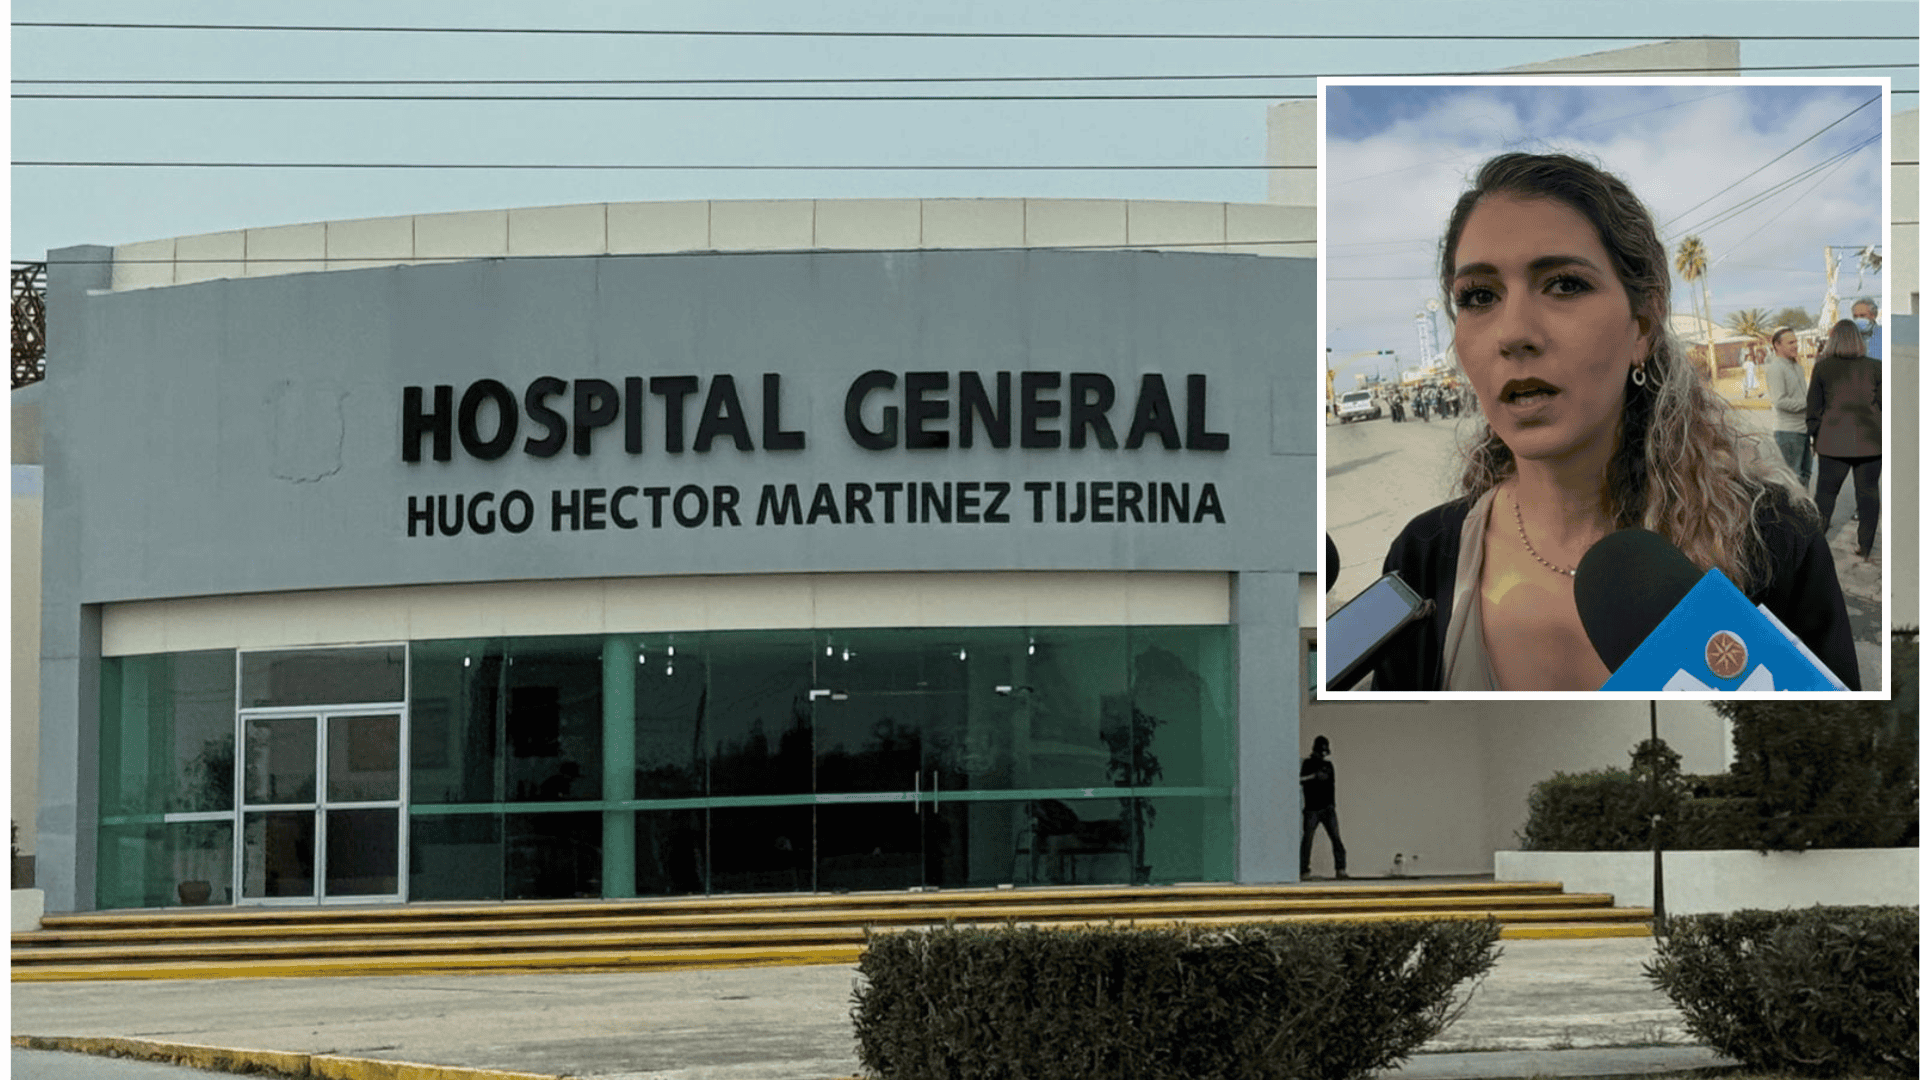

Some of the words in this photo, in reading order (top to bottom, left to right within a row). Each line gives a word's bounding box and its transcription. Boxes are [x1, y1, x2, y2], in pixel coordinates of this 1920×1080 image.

[402, 373, 805, 462] HOSPITAL
[845, 369, 1230, 453] GENERAL
[407, 490, 534, 537] HUGO
[551, 484, 741, 532] HECTOR
[755, 481, 1011, 526] MARTINEZ
[1024, 481, 1226, 524] TIJERINA
